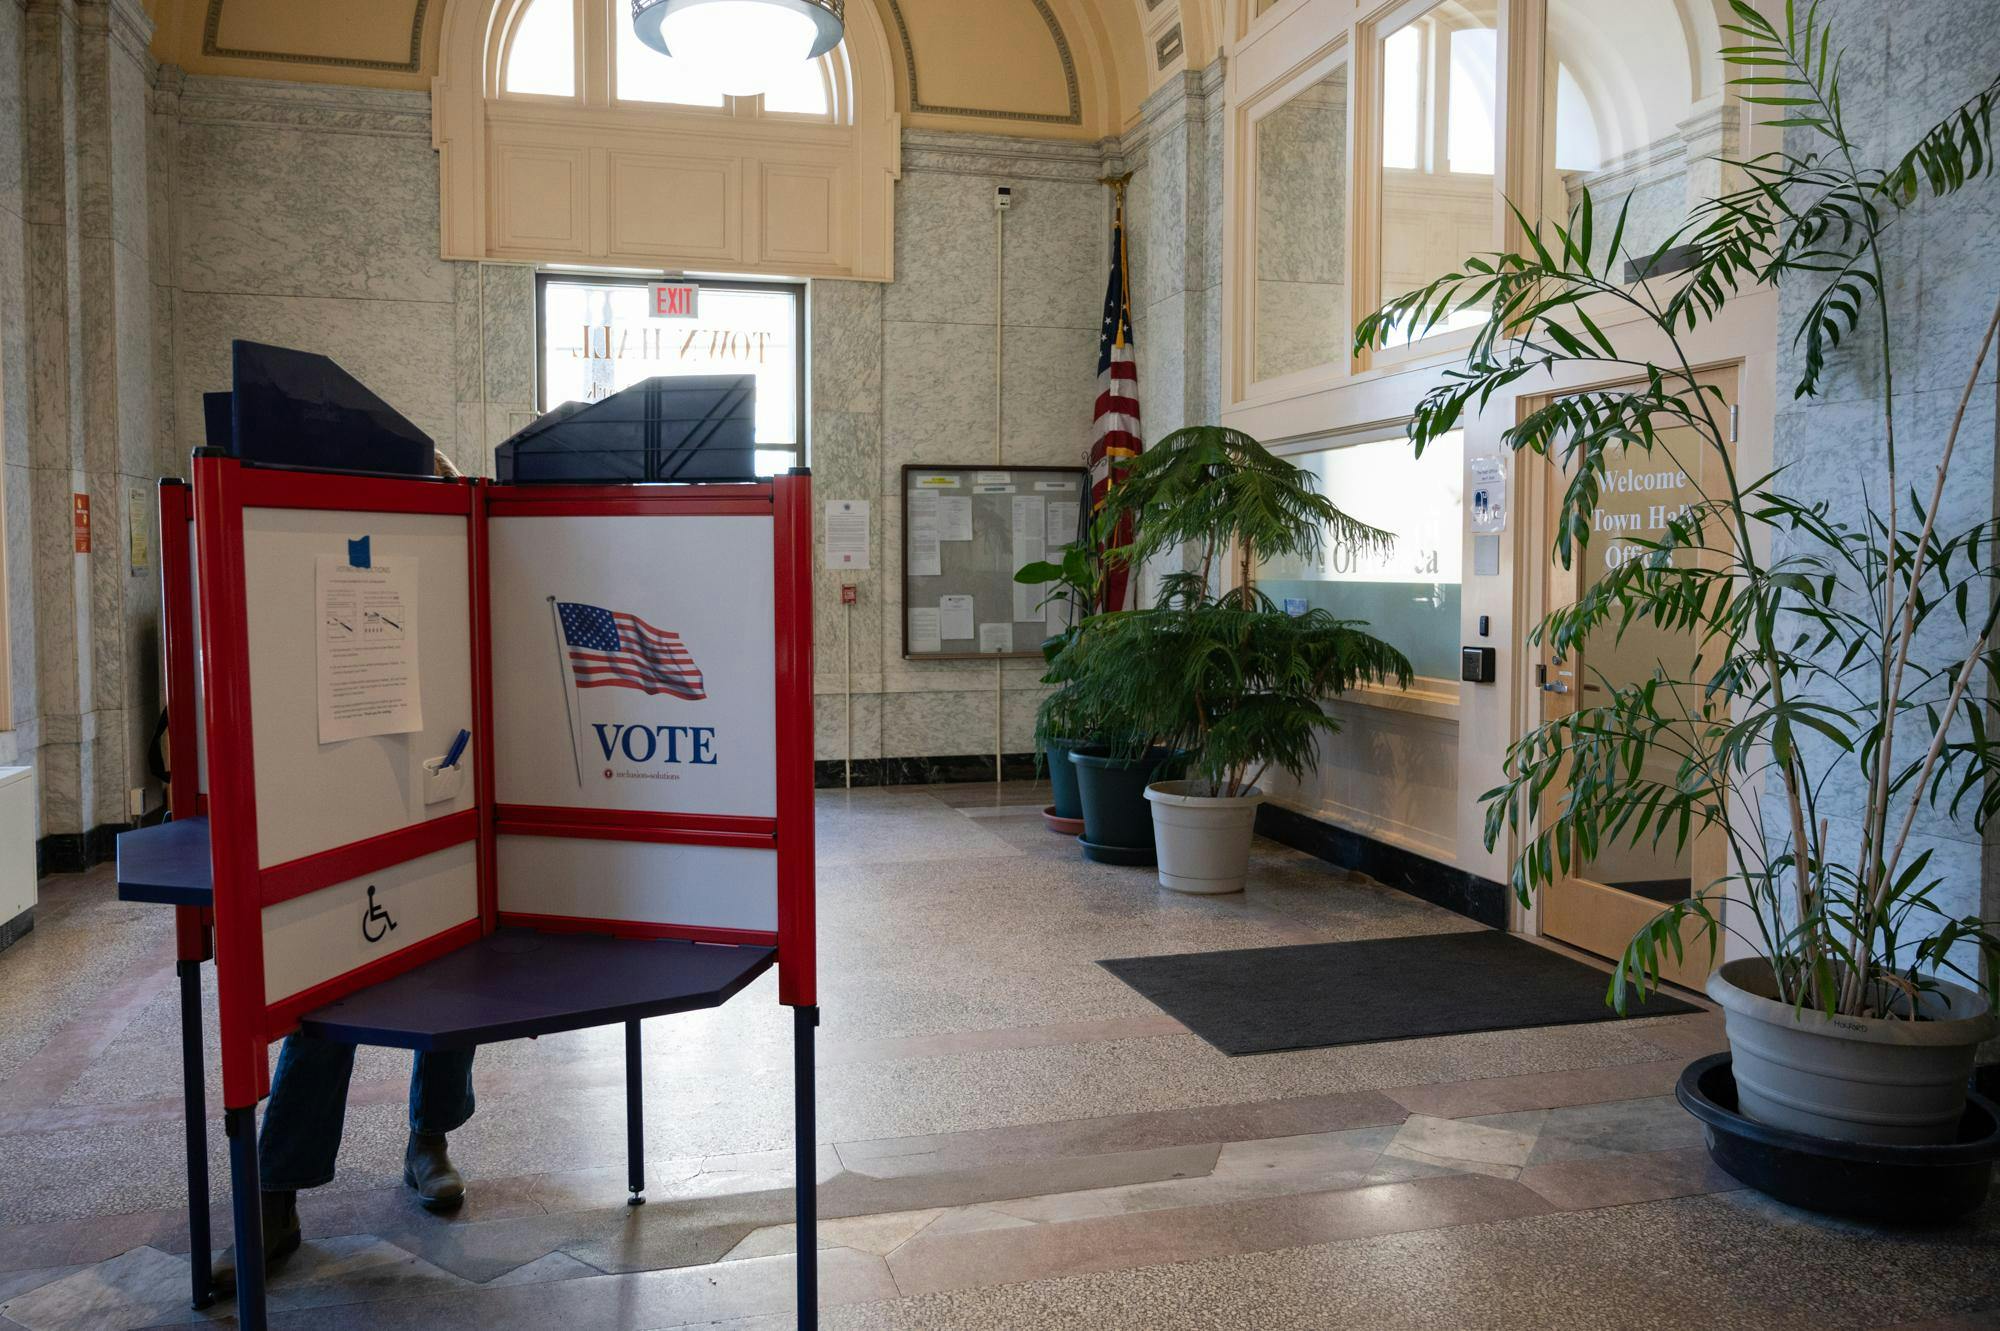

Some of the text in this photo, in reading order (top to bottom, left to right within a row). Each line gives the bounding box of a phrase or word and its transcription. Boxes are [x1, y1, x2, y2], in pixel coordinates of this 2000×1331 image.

[657, 287, 692, 314] EXIT
[1600, 468, 1686, 494] Welcome
[1594, 508, 1642, 532] Town
[591, 723, 718, 765] VOTE
